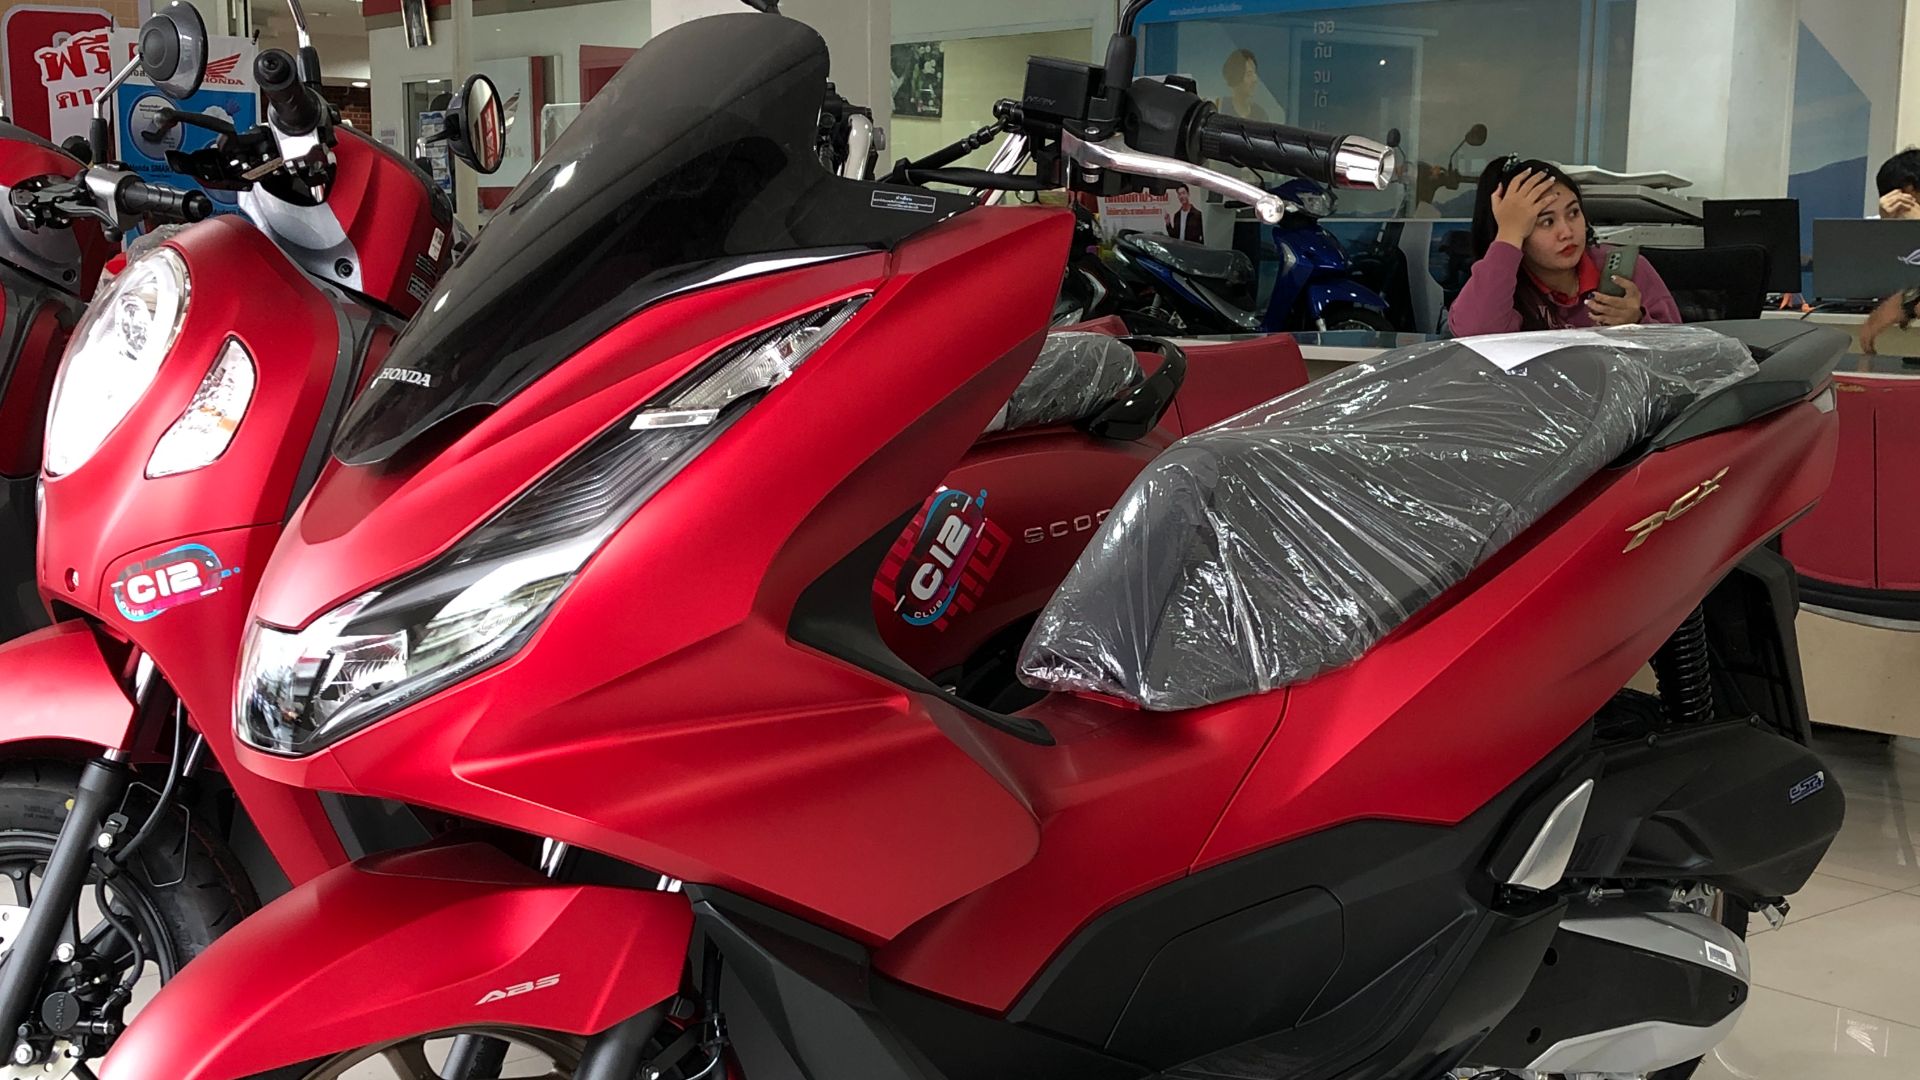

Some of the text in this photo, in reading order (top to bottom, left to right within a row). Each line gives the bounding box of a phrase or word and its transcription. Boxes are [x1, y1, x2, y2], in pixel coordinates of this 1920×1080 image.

[380, 367, 432, 388] HONDA
[914, 600, 943, 619] CLUB
[474, 973, 561, 1006] ABS
